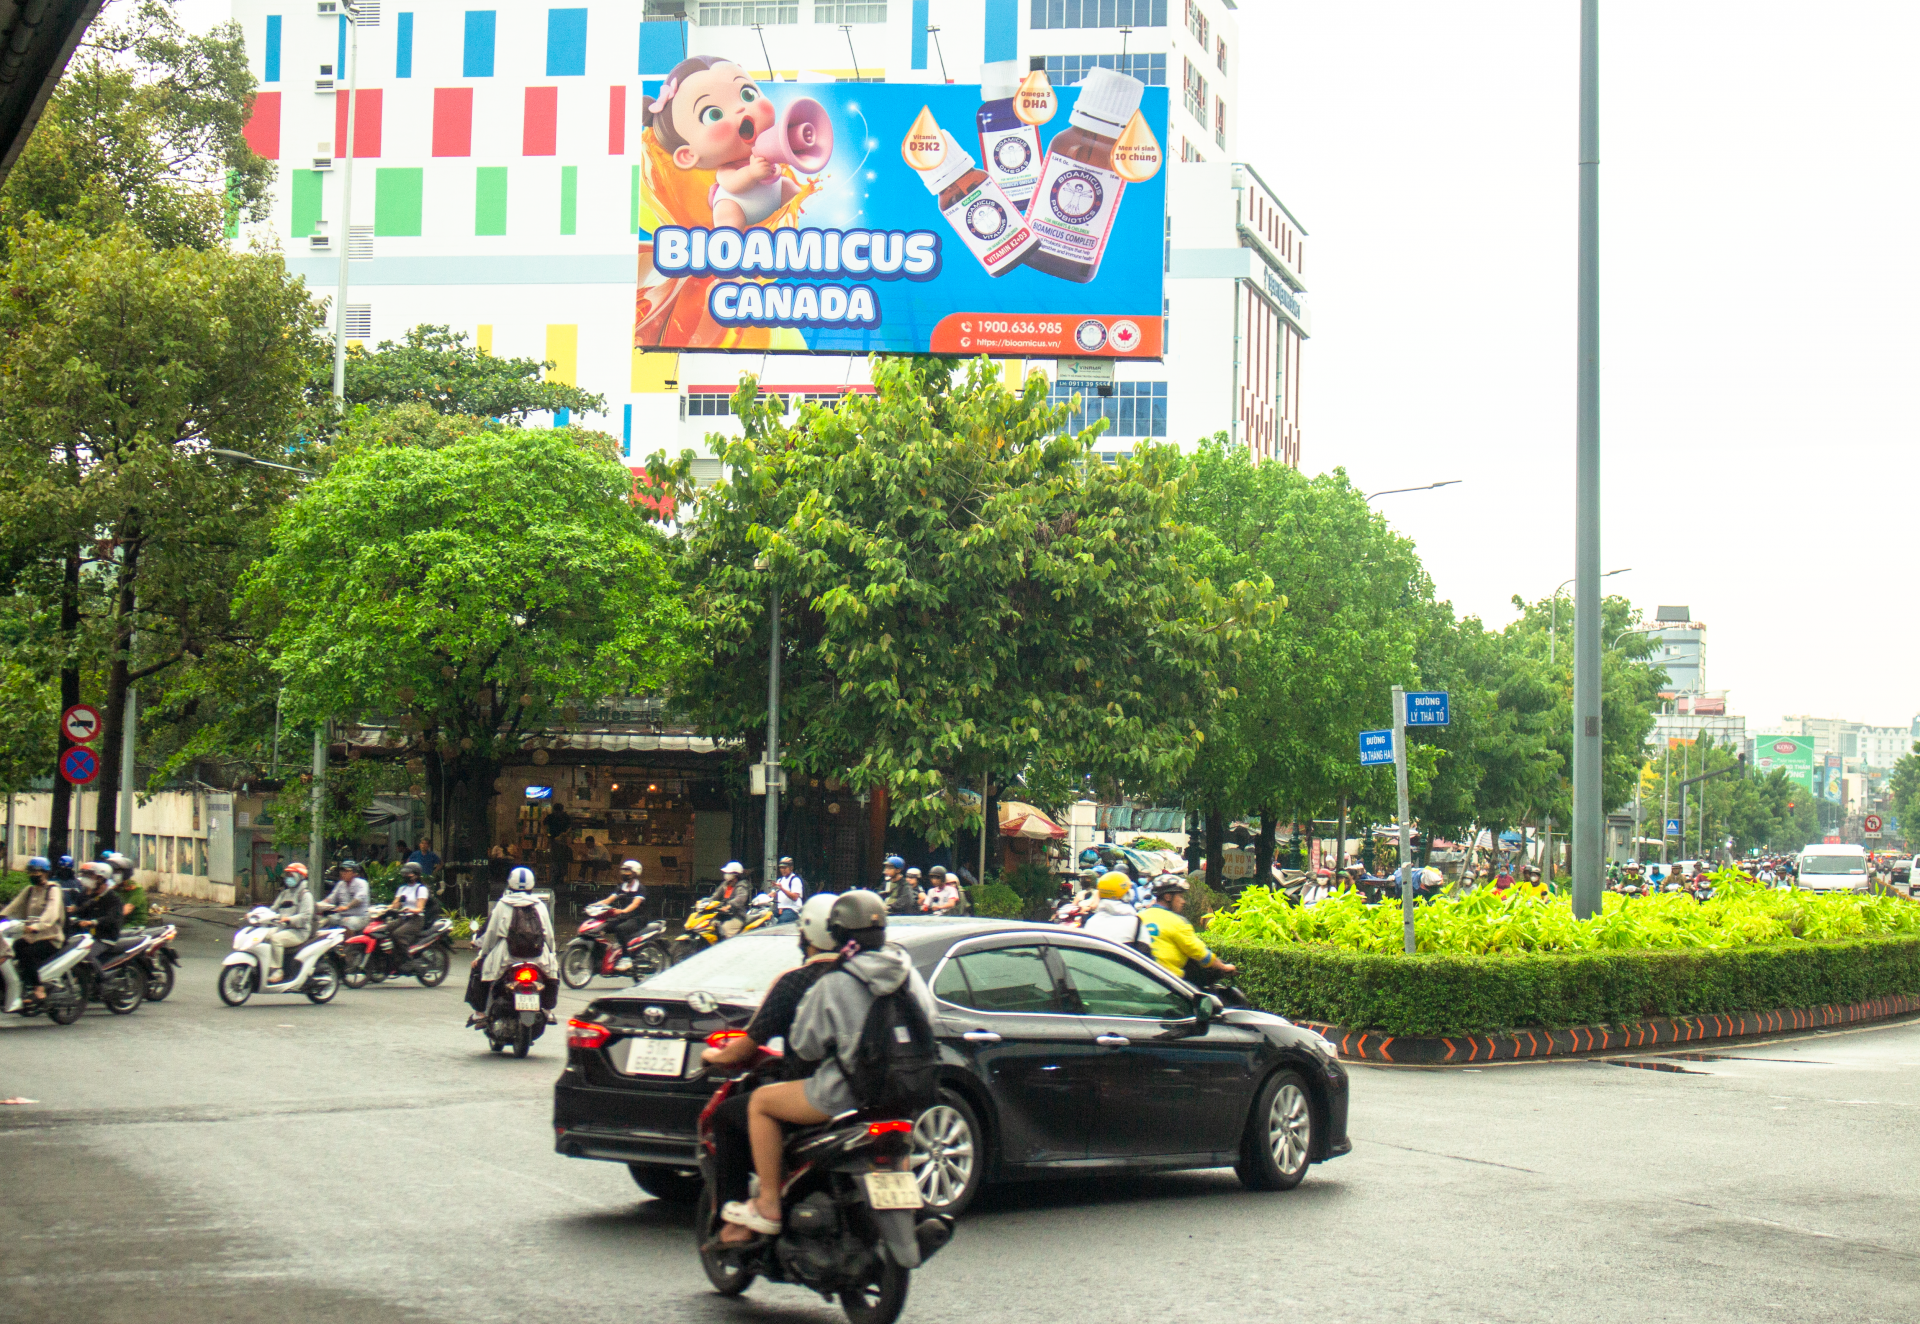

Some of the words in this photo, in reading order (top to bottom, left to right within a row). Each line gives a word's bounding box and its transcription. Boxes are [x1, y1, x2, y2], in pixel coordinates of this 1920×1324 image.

[1023, 99, 1047, 108] DHA
[910, 142, 940, 151] D3K2
[996, 137, 1027, 152] BIOAMICUS
[1129, 152, 1157, 162] chủng
[1058, 171, 1102, 196] BIOAMICUS
[968, 200, 995, 224] BIOAMICUS
[1051, 200, 1096, 223] PROBIOTICS
[983, 219, 1006, 239] VITAMINS
[1031, 221, 1065, 239] BIOAMICUS
[1064, 232, 1095, 247] COMPLETE
[656, 228, 937, 276] BIOAMICUS
[986, 244, 1011, 264] VITAMIN
[1008, 230, 1028, 247] K2+D3
[711, 284, 877, 322] CANADA
[978, 321, 1062, 334] 1900.636.985
[976, 339, 1061, 348] https://bioamicus.vn/
[1415, 696, 1440, 706] ĐƯỜNG
[1411, 709, 1418, 722] LÝ
[1421, 708, 1434, 721] THÁI
[1436, 706, 1444, 721] TỔ
[1366, 735, 1385, 745] ĐƯỜNG
[1362, 751, 1368, 762] BA
[1368, 748, 1383, 761] THÁNG
[1384, 749, 1392, 760] HAI
